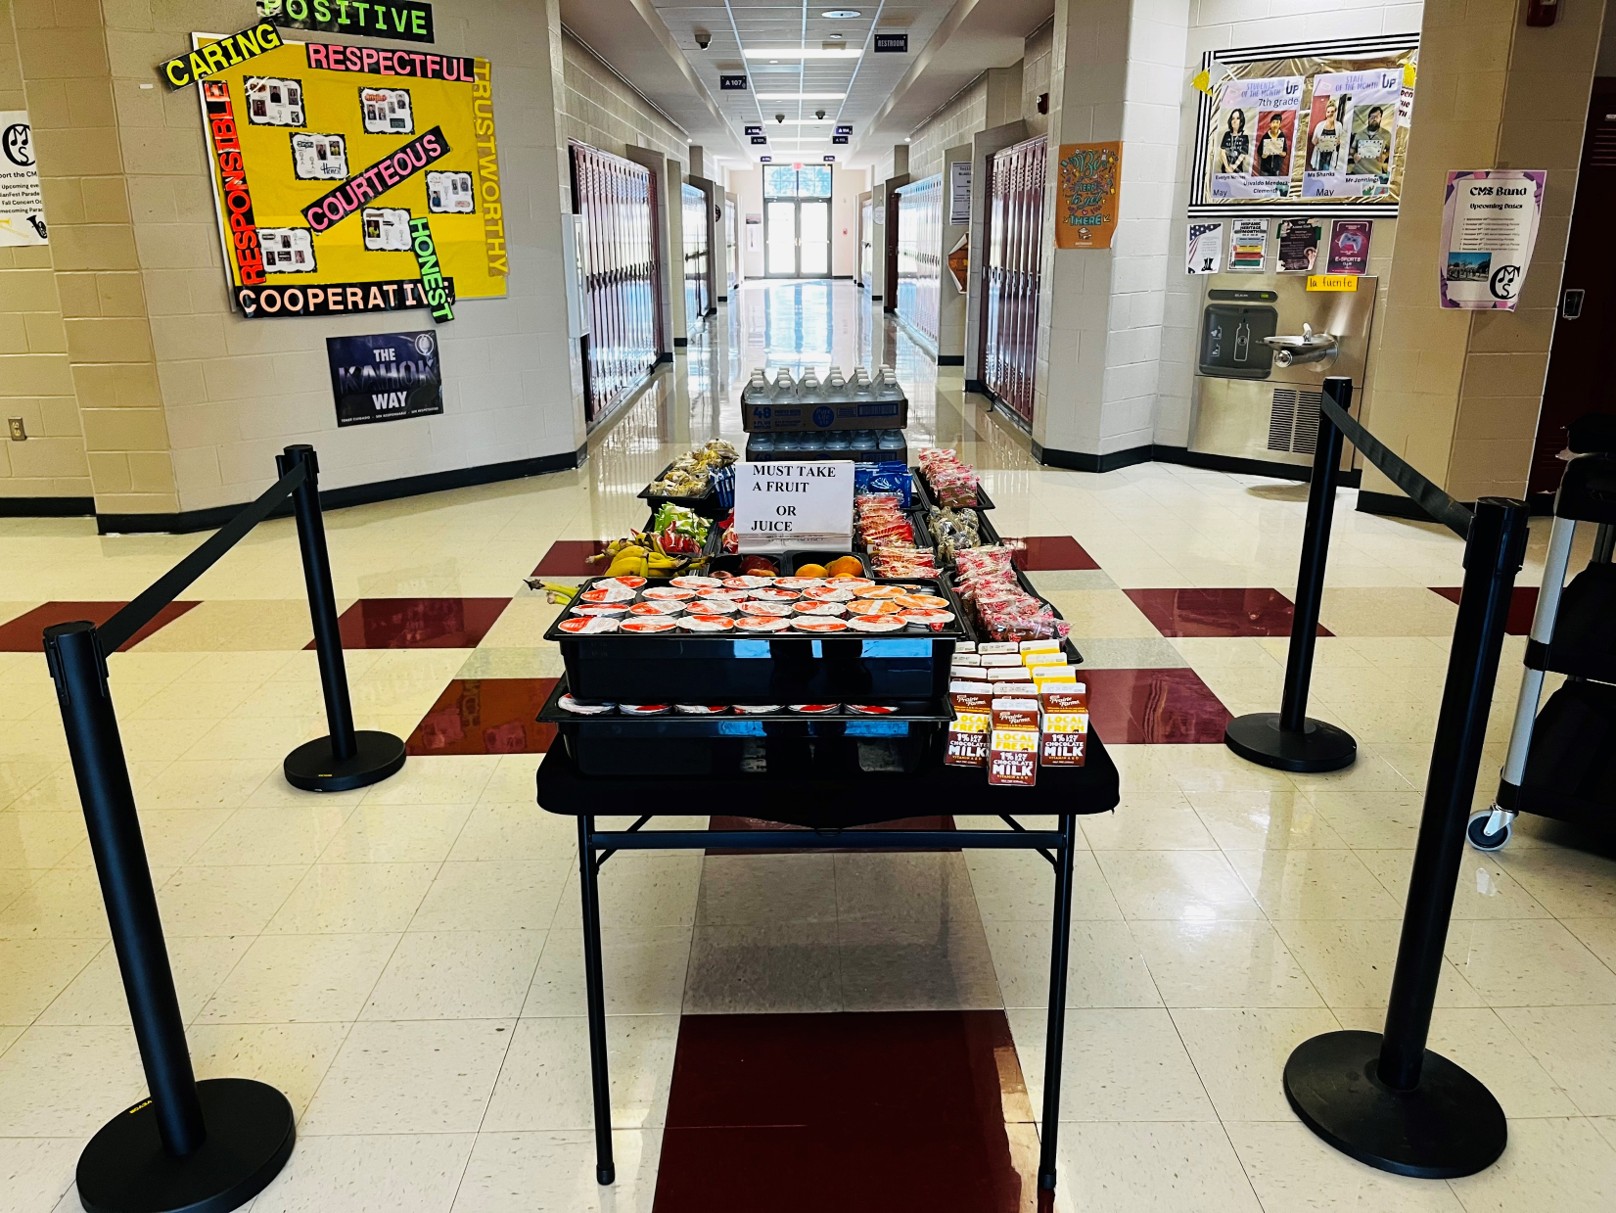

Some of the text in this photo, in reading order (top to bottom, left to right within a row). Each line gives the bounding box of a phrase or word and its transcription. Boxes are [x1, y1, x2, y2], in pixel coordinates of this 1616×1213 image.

[266, 0, 427, 35] POSITIVE
[877, 39, 905, 47] RESTROOM
[166, 23, 281, 86] CARING
[308, 43, 474, 82] RESPECTFUL
[1382, 73, 1396, 88] UP
[1286, 80, 1299, 95] UP
[1259, 97, 1298, 107] 7th grade
[474, 60, 508, 275] TRUSTWORTHY
[204, 82, 266, 285] RESPONSIBLE
[307, 134, 441, 230] COURTEOUS
[1213, 188, 1228, 197] May
[1316, 188, 1335, 197] May
[1469, 186, 1527, 196] CMS Band
[1070, 214, 1101, 226] THERE
[409, 217, 454, 320] HONEST
[1310, 277, 1352, 287] la fuente
[373, 348, 396, 362] THE
[338, 359, 438, 394] KAHOK
[372, 391, 407, 410] WAY
[753, 406, 772, 419] 48
[753, 465, 836, 478] MUST TAKE
[752, 481, 809, 492] A FRUIT
[776, 505, 797, 516] OR
[751, 521, 793, 532] JUICE
[957, 733, 970, 742] 1%
[996, 733, 1033, 742] LOCAL
[1052, 733, 1065, 742] 1%
[948, 746, 986, 757] MILK
[1000, 752, 1014, 760] 1%
[1044, 746, 1083, 757] MILK
[992, 765, 1032, 776] MILK
